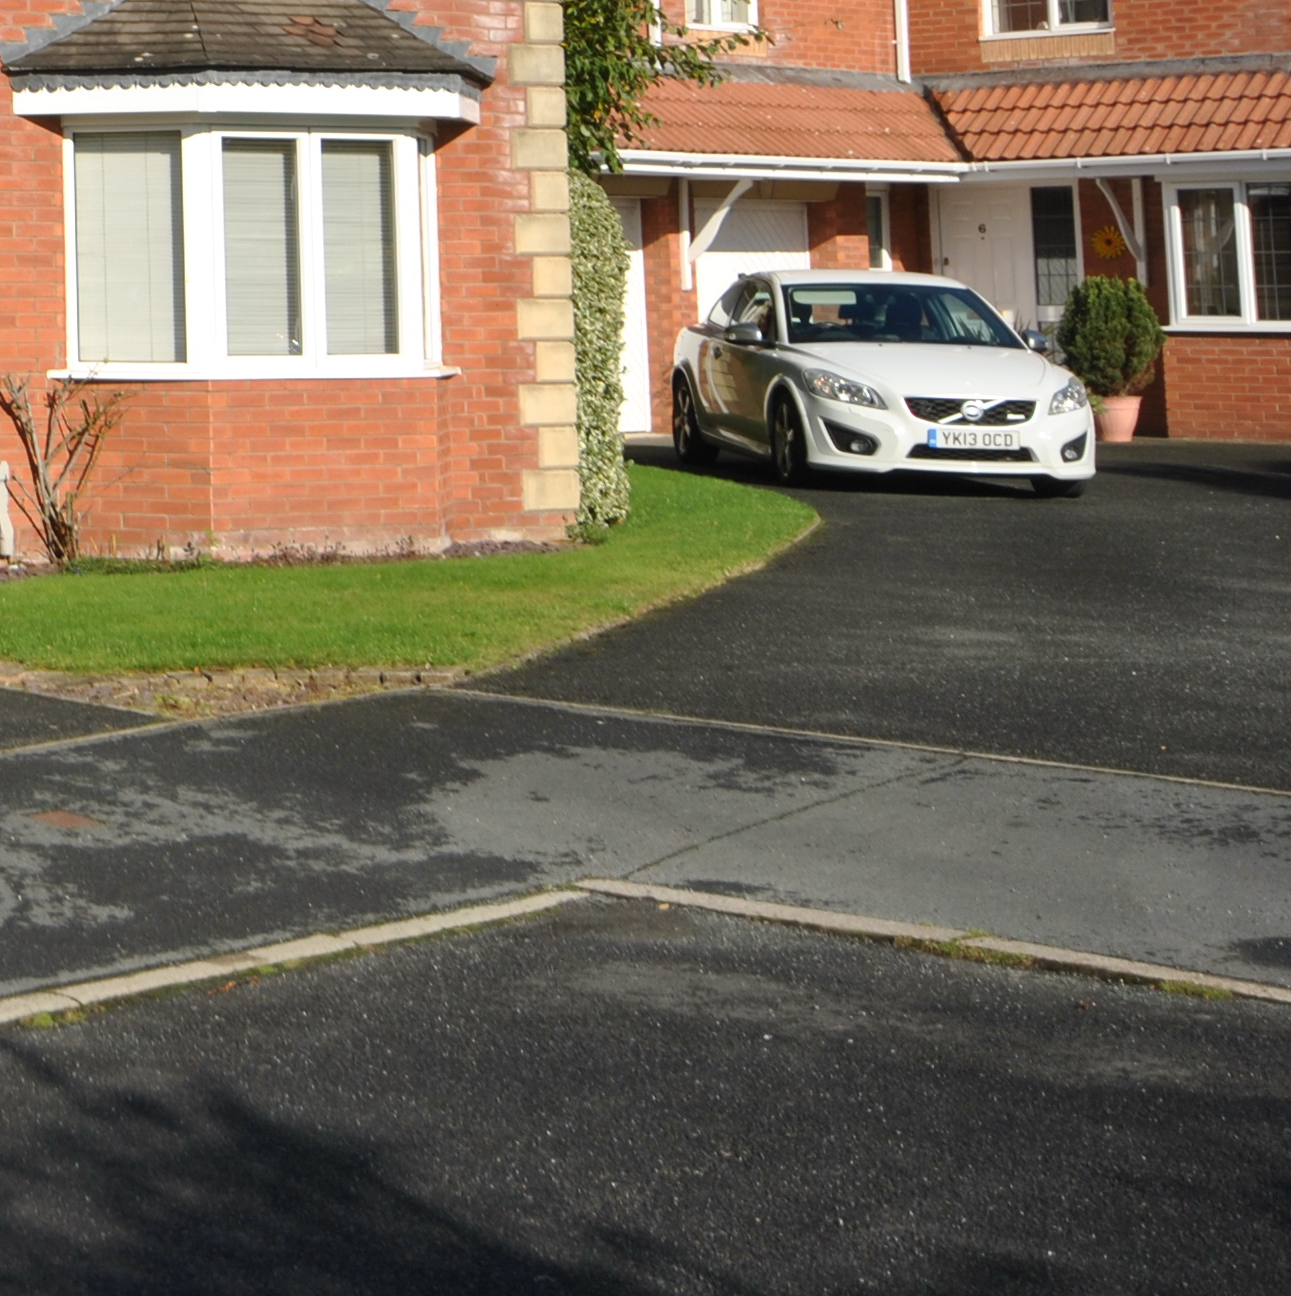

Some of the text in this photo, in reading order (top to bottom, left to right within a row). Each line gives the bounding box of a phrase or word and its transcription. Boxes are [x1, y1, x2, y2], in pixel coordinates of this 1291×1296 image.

[977, 223, 987, 234] 6
[942, 431, 1013, 447] YK13 OCD
